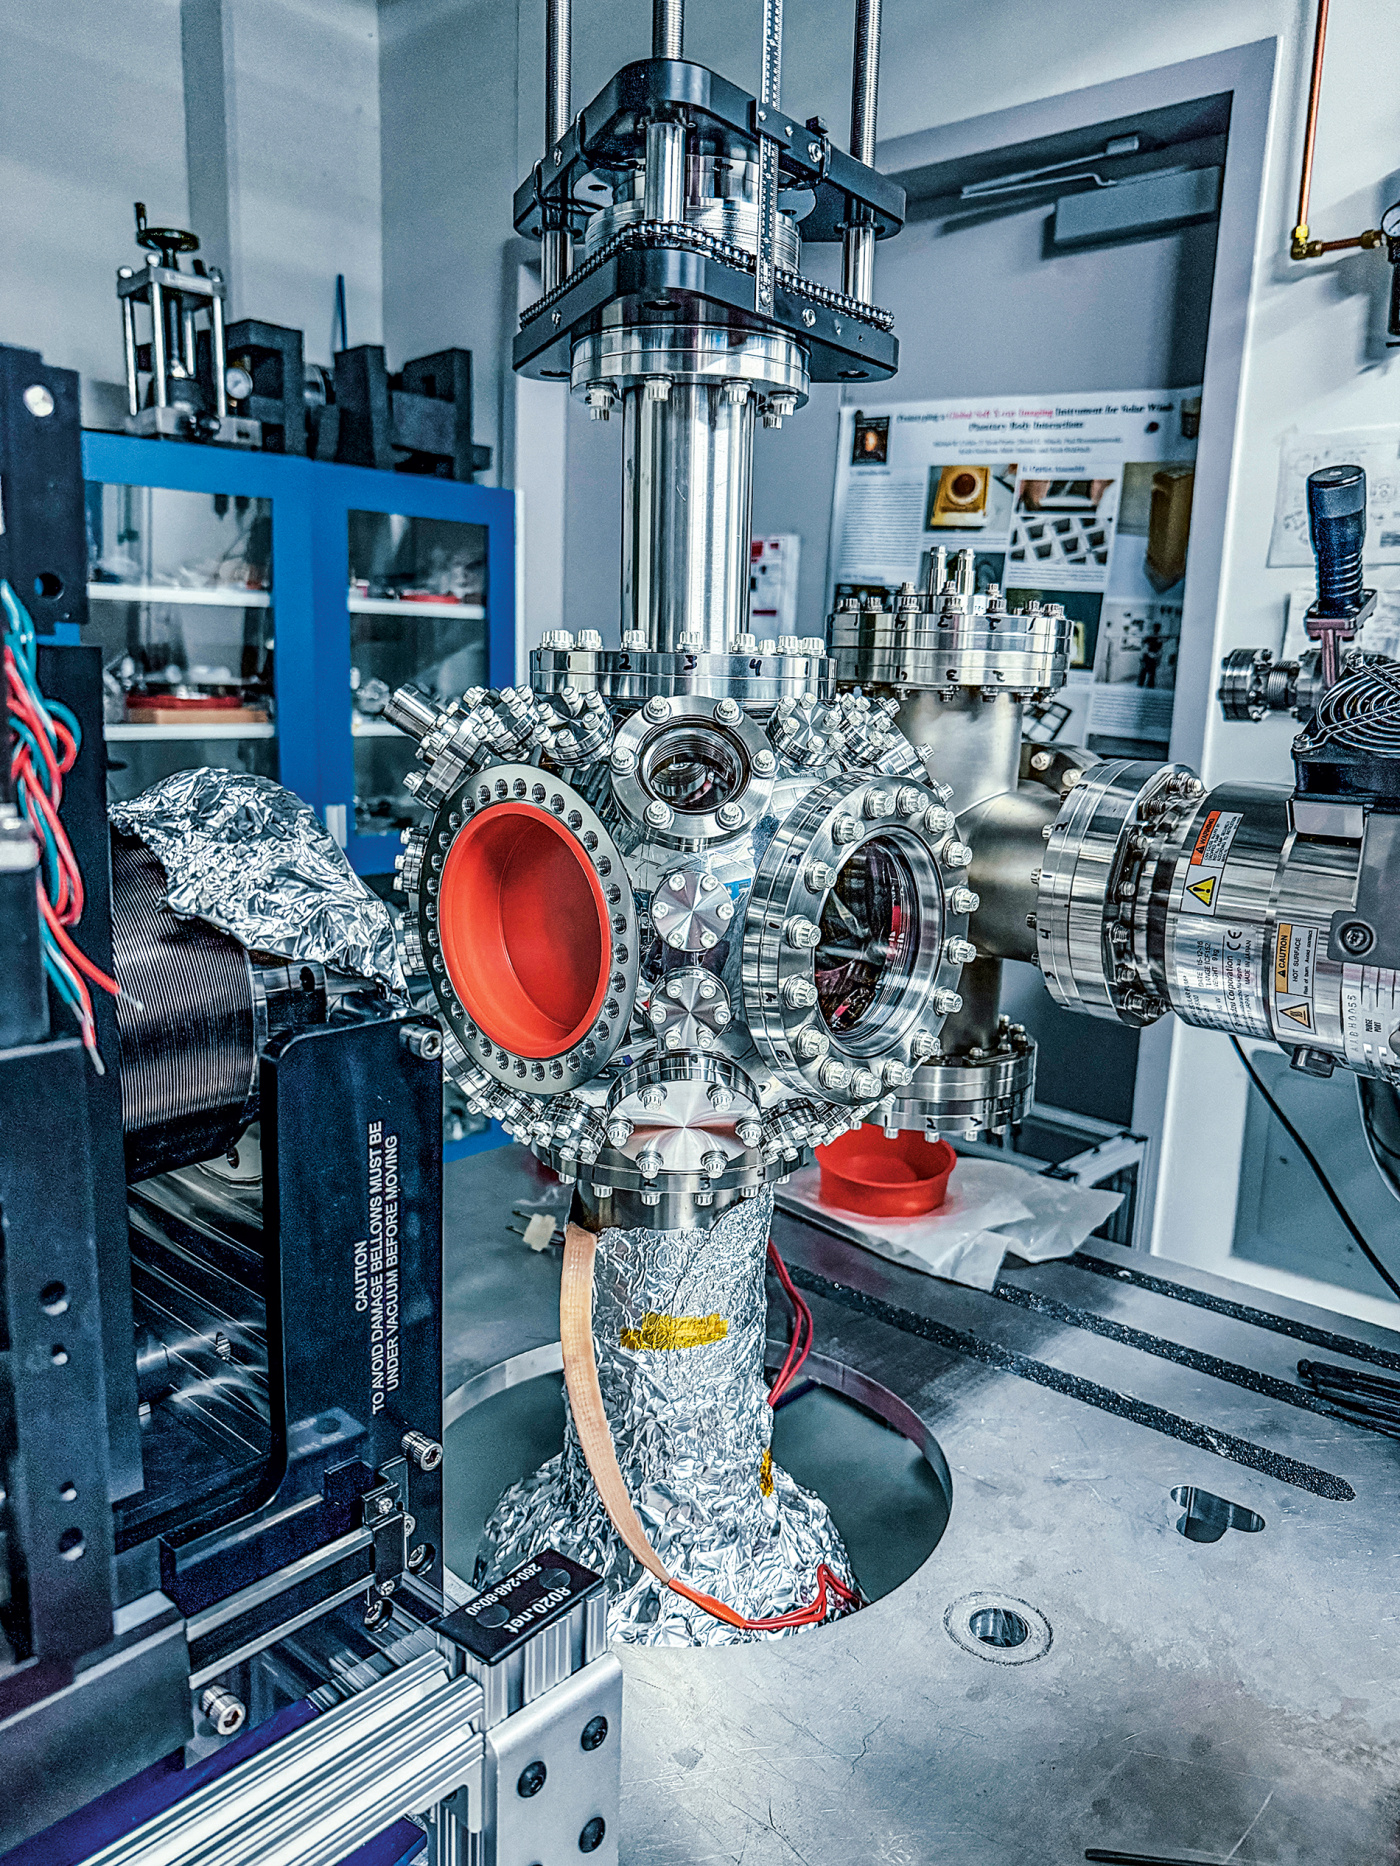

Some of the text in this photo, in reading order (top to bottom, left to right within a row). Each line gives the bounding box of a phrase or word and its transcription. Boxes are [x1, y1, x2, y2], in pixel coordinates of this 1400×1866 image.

[619, 654, 632, 670] 2
[684, 654, 698, 670] 3
[749, 658, 762, 676] 4
[1279, 935, 1288, 968] CAUTION
[1293, 938, 1301, 966] SURFACE
[1225, 956, 1235, 1000] Corporation
[355, 1241, 368, 1312] CAUTION
[368, 1121, 385, 1415] TO AVOID DAMAGE BELLOWS MUST BE
[385, 1135, 399, 1391] UNDER VACUUM BEFORE MOVING
[503, 1587, 572, 1634] 8020.net
